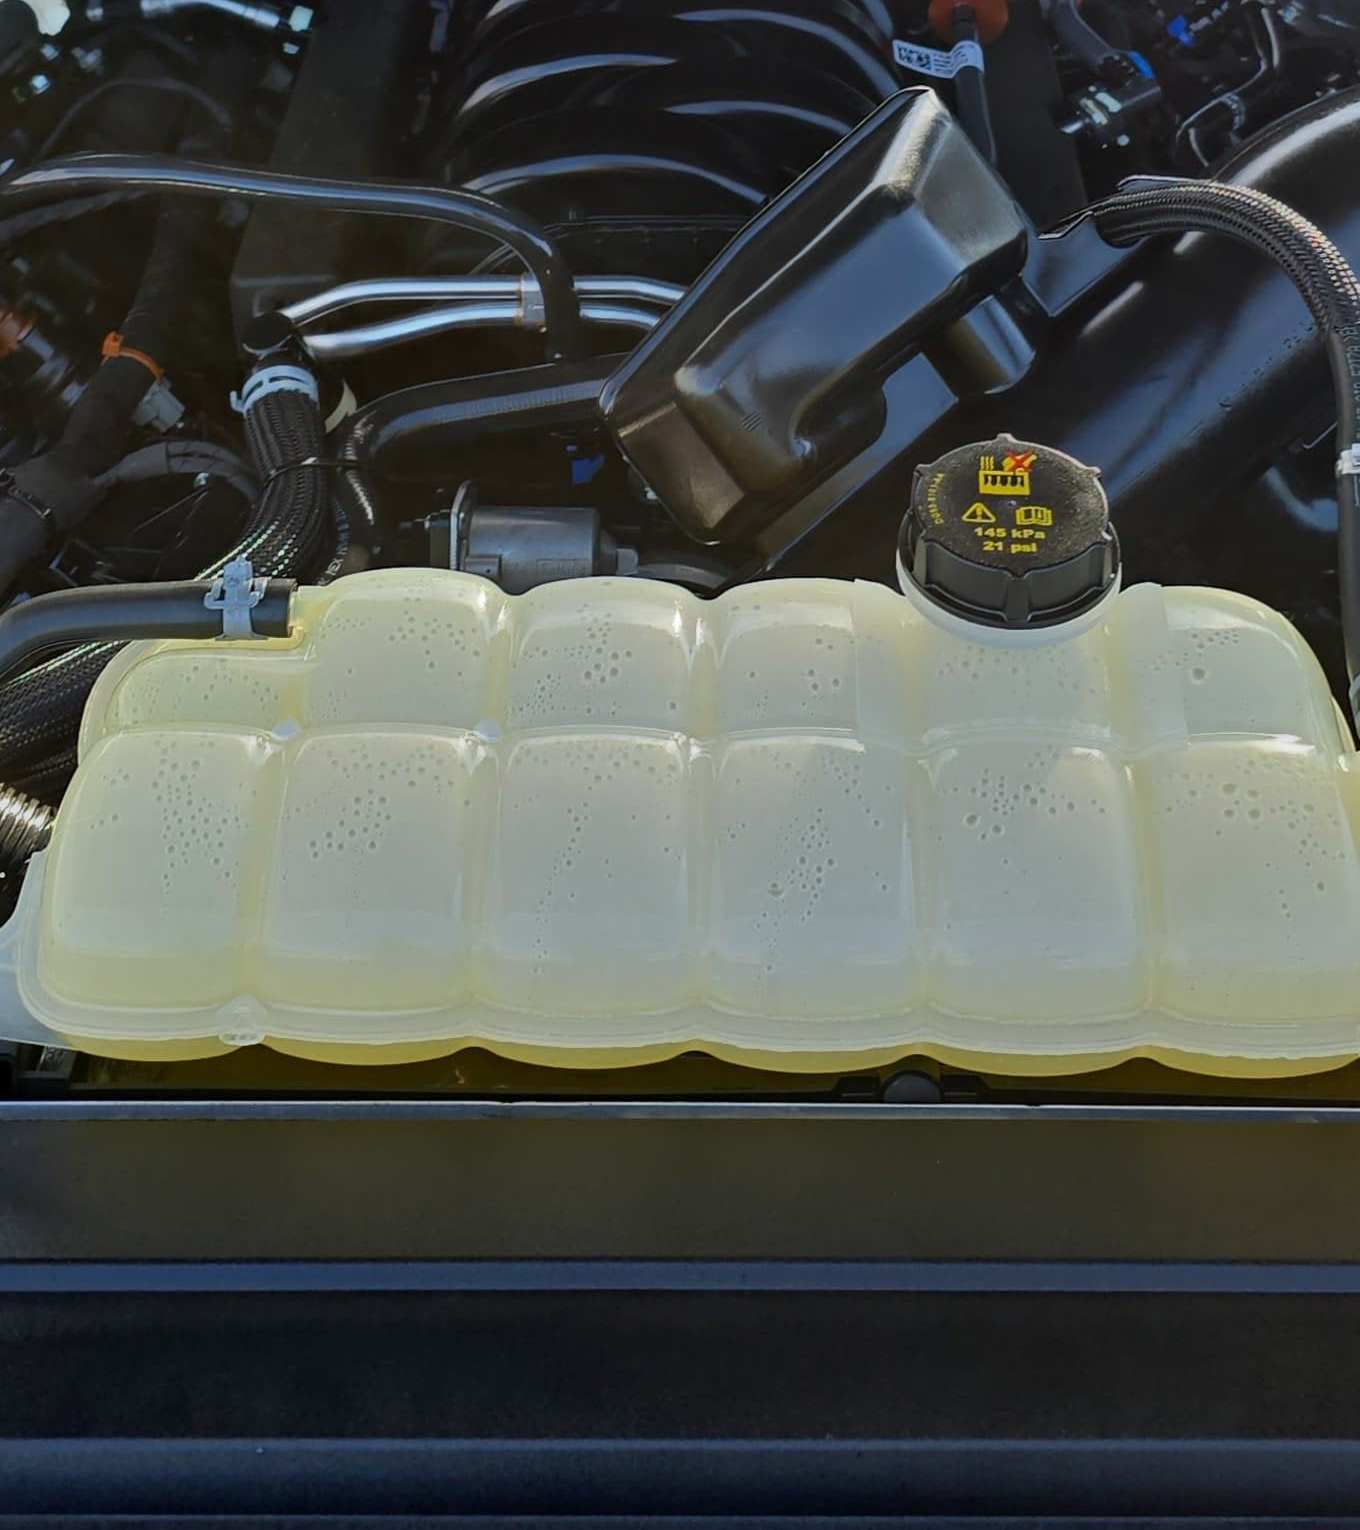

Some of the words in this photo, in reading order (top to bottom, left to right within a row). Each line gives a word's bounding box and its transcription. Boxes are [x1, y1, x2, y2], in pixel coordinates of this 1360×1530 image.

[974, 527, 1007, 538] 145
[1011, 529, 1046, 539] kPa
[983, 541, 1004, 551] 21
[1011, 542, 1038, 554] psi
